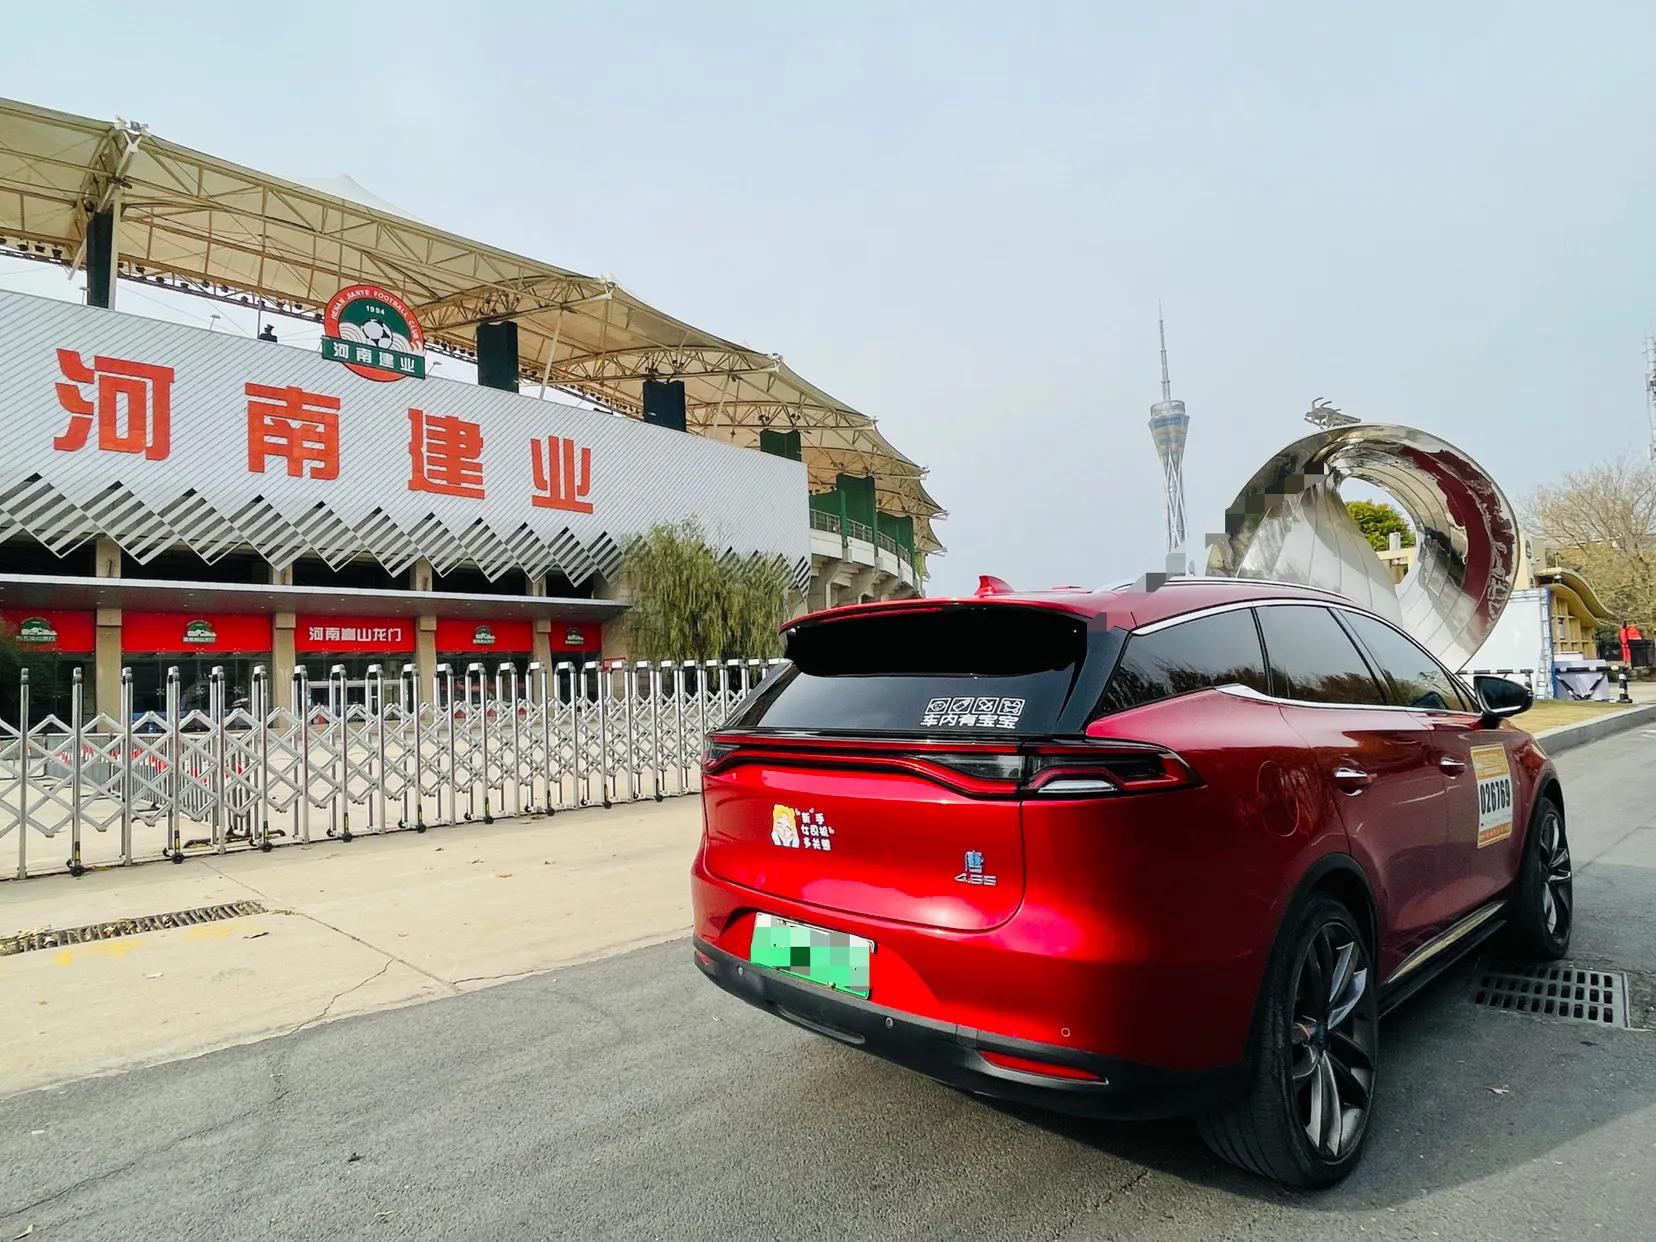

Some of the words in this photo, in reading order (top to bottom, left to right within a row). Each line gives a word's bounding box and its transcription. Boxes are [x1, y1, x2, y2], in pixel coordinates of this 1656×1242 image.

[365, 305, 386, 315] 1994
[373, 290, 409, 318] FOOTBALL
[408, 320, 420, 339] CLUB
[333, 342, 415, 373] 河南建业
[53, 347, 594, 514] 河南建业
[919, 713, 1019, 730] 车内有宝宝
[801, 824, 829, 837] 女司机
